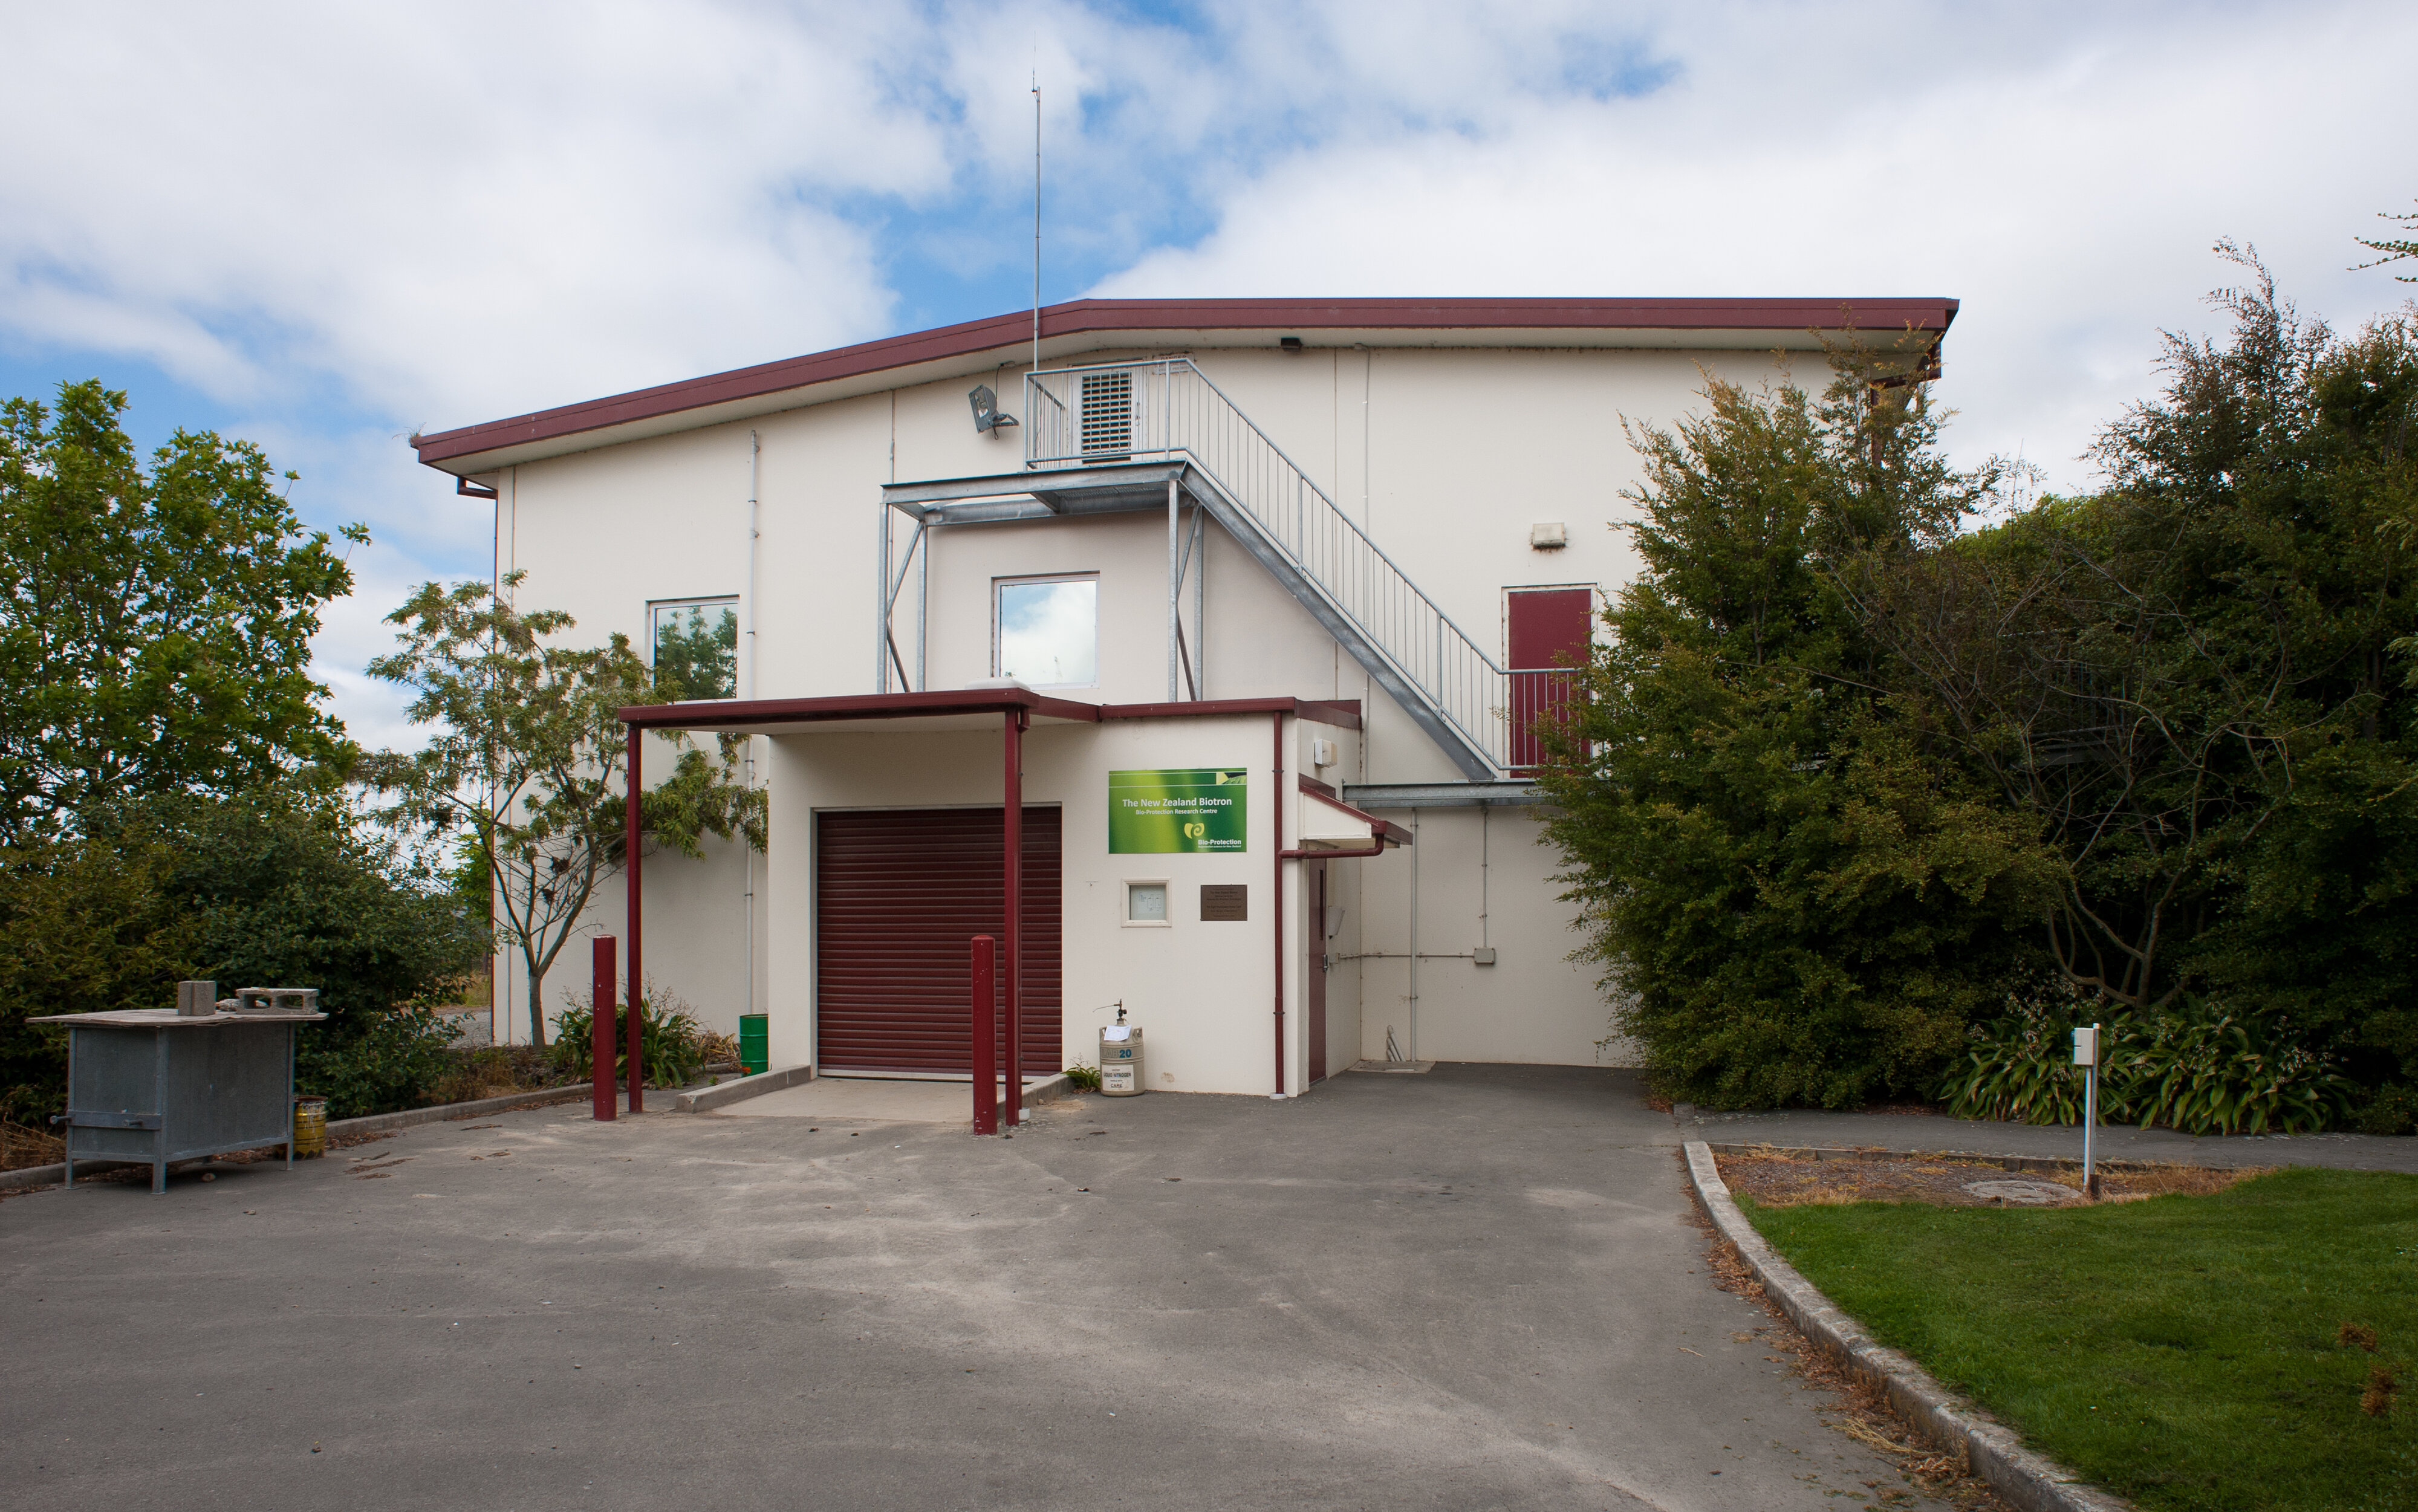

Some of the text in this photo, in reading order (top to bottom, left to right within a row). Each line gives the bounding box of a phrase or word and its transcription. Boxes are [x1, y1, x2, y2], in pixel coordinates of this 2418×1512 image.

[1122, 797, 1232, 807] The New Zealand Biotron
[1119, 1049, 1131, 1058] 20
